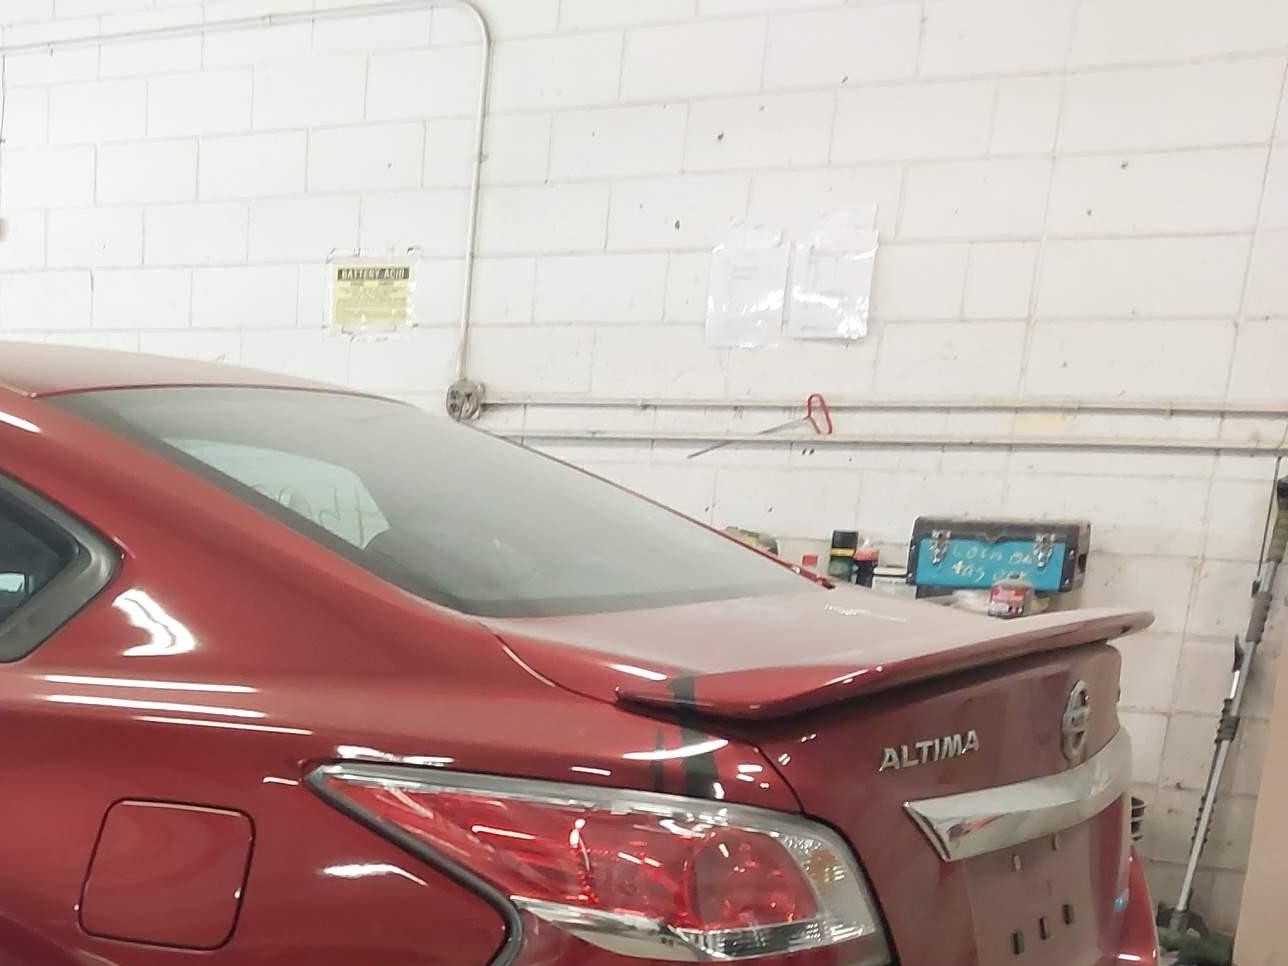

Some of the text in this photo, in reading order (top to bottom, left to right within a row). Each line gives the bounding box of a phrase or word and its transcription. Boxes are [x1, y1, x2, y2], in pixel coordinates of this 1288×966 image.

[341, 268, 405, 280] BATTERY ACID
[878, 729, 980, 772] ALTIMA
